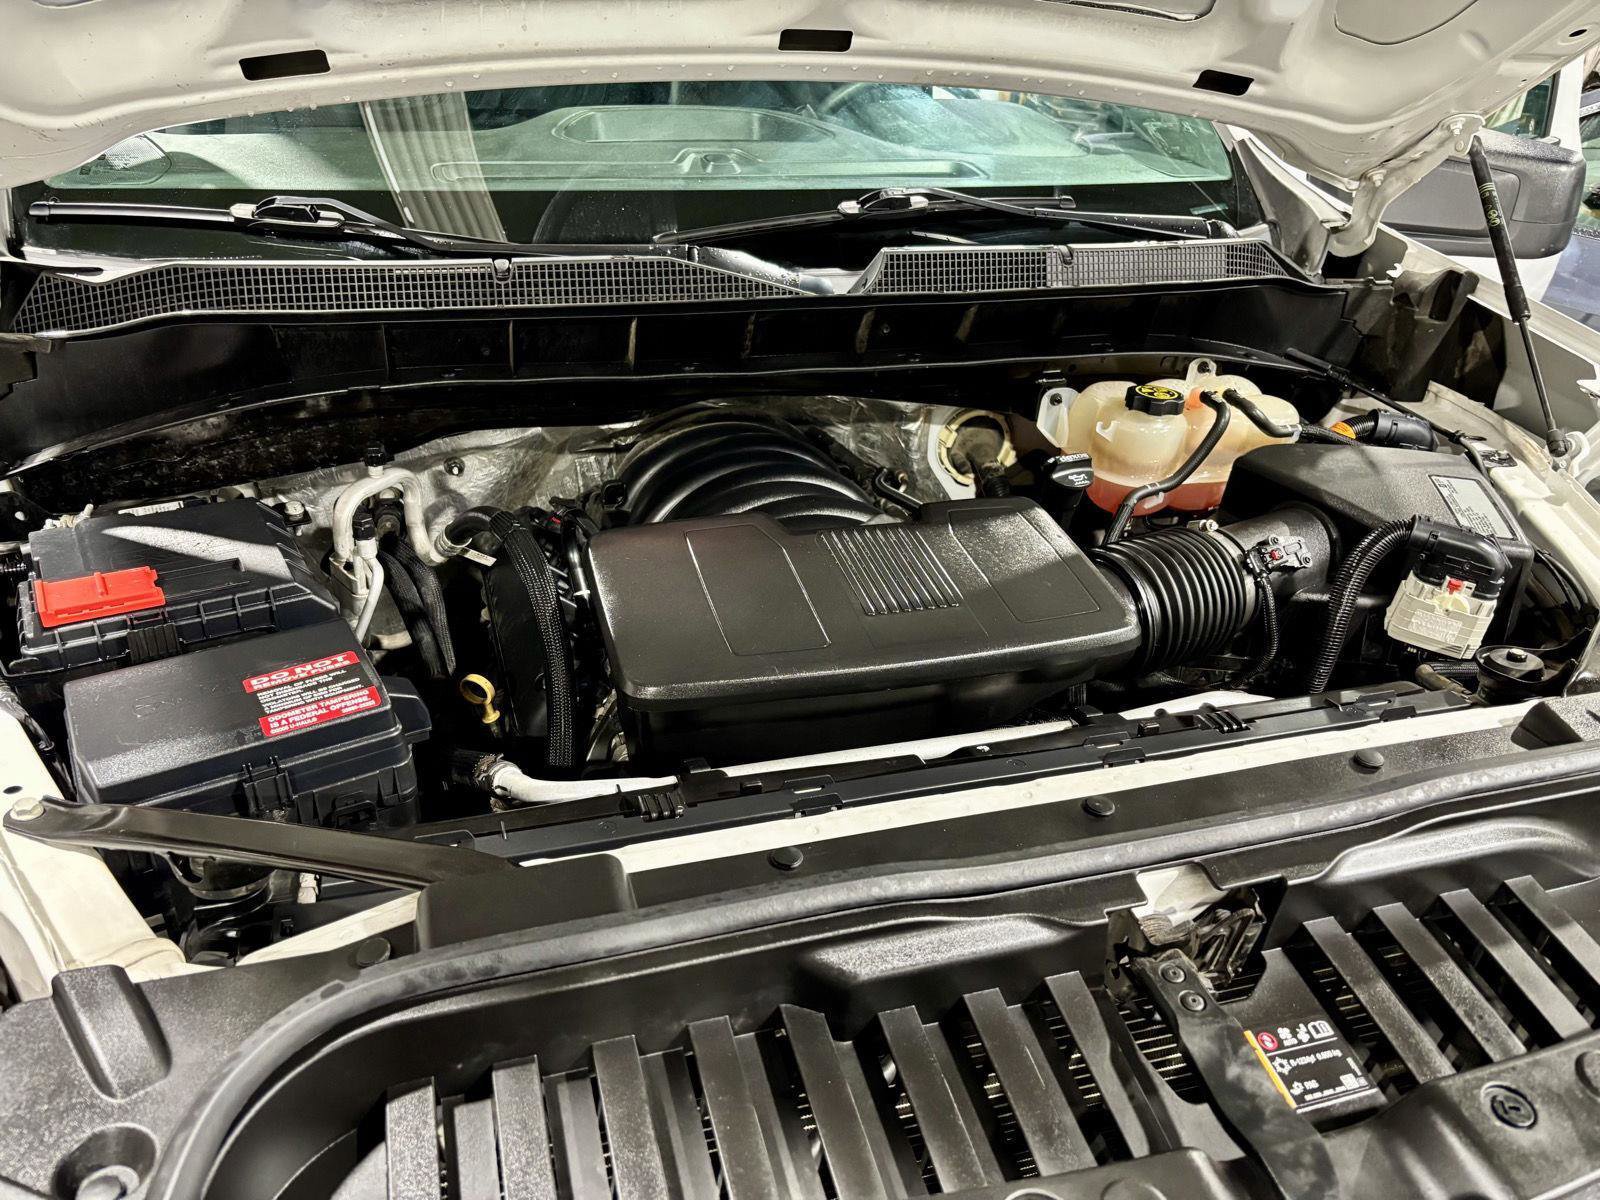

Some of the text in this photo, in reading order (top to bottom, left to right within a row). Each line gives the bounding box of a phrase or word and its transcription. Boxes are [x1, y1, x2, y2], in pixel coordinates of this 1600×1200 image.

[250, 655, 346, 686] DO NOT
[268, 704, 318, 722] ODOMETER
[319, 689, 368, 707] TAMPERING
[288, 708, 328, 723] FEDERAL
